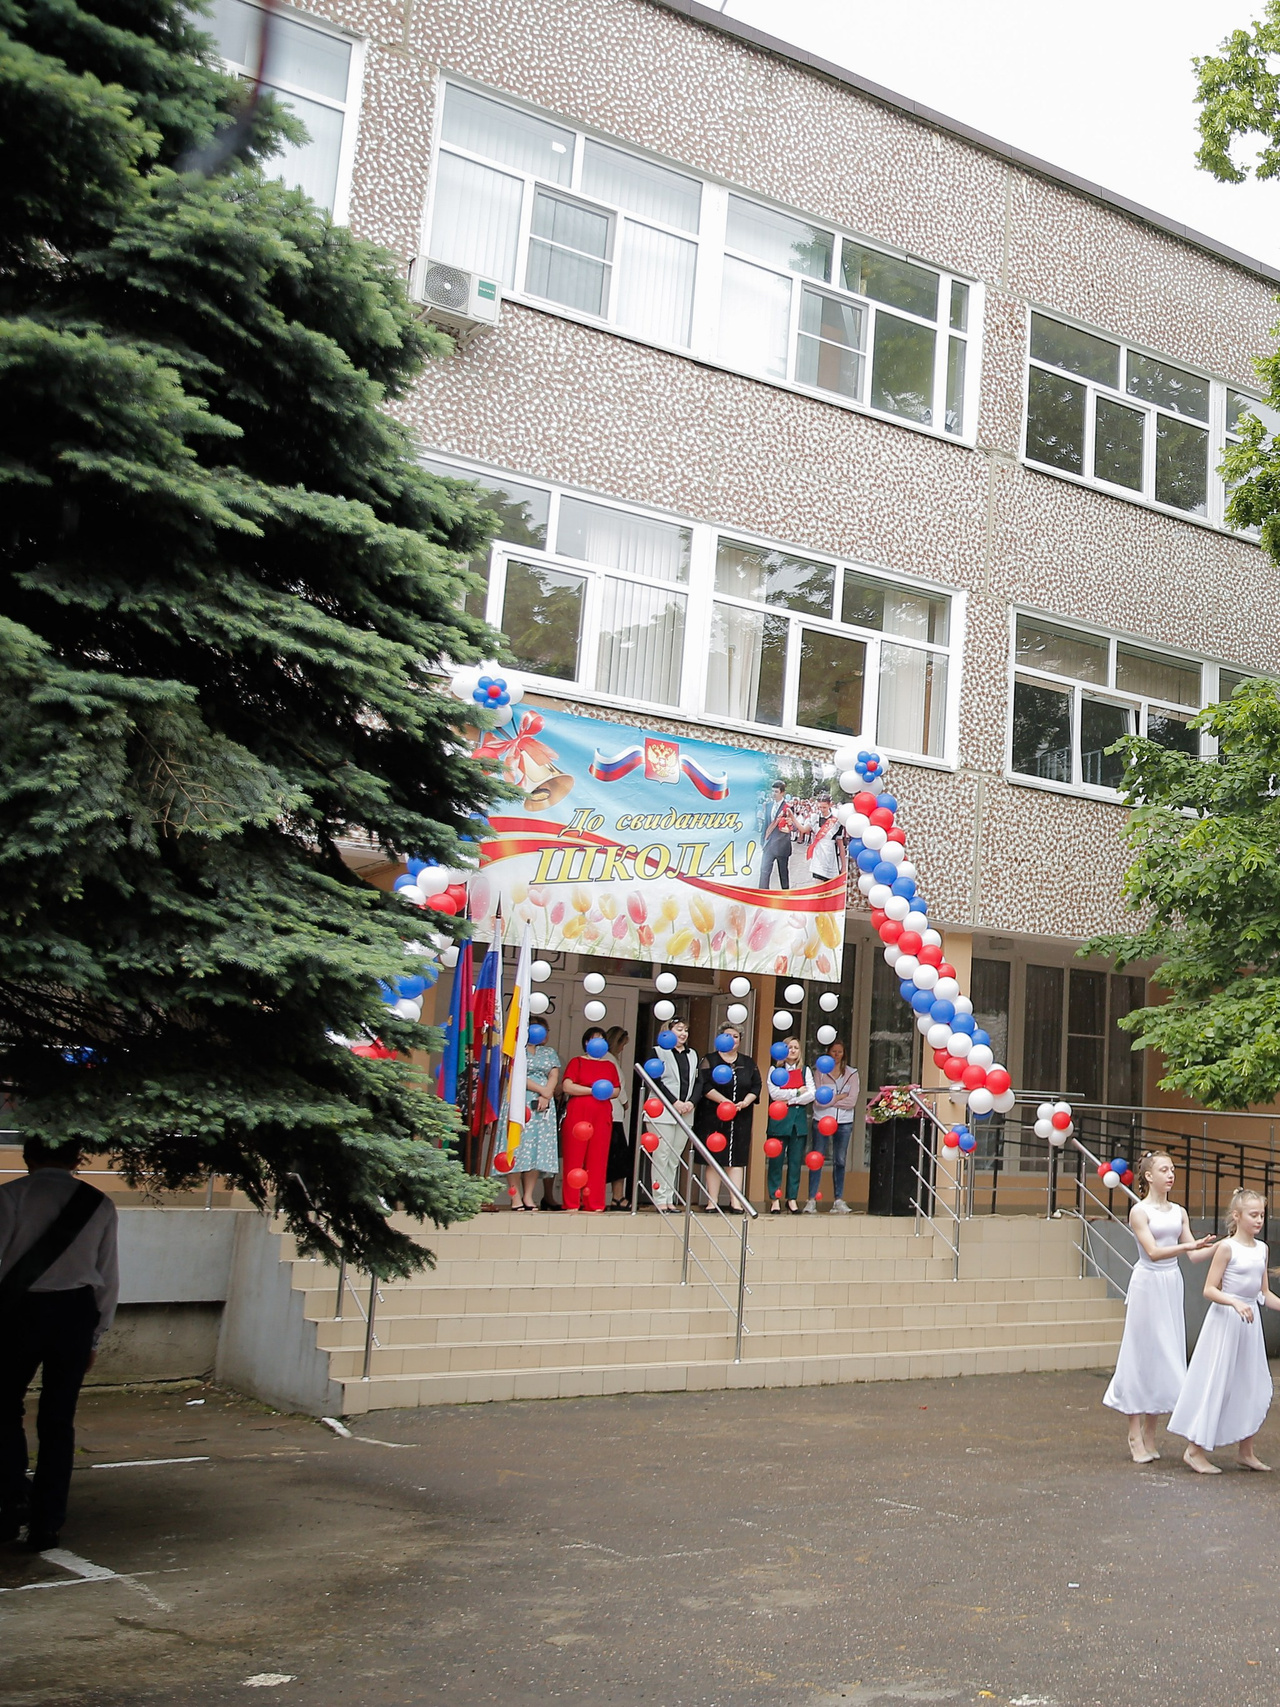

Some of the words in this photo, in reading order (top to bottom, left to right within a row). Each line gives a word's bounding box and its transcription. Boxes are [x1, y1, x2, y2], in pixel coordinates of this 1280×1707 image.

[558, 808, 605, 838] До
[615, 807, 743, 832] свидания,
[529, 840, 756, 885] ШКОЛА!
